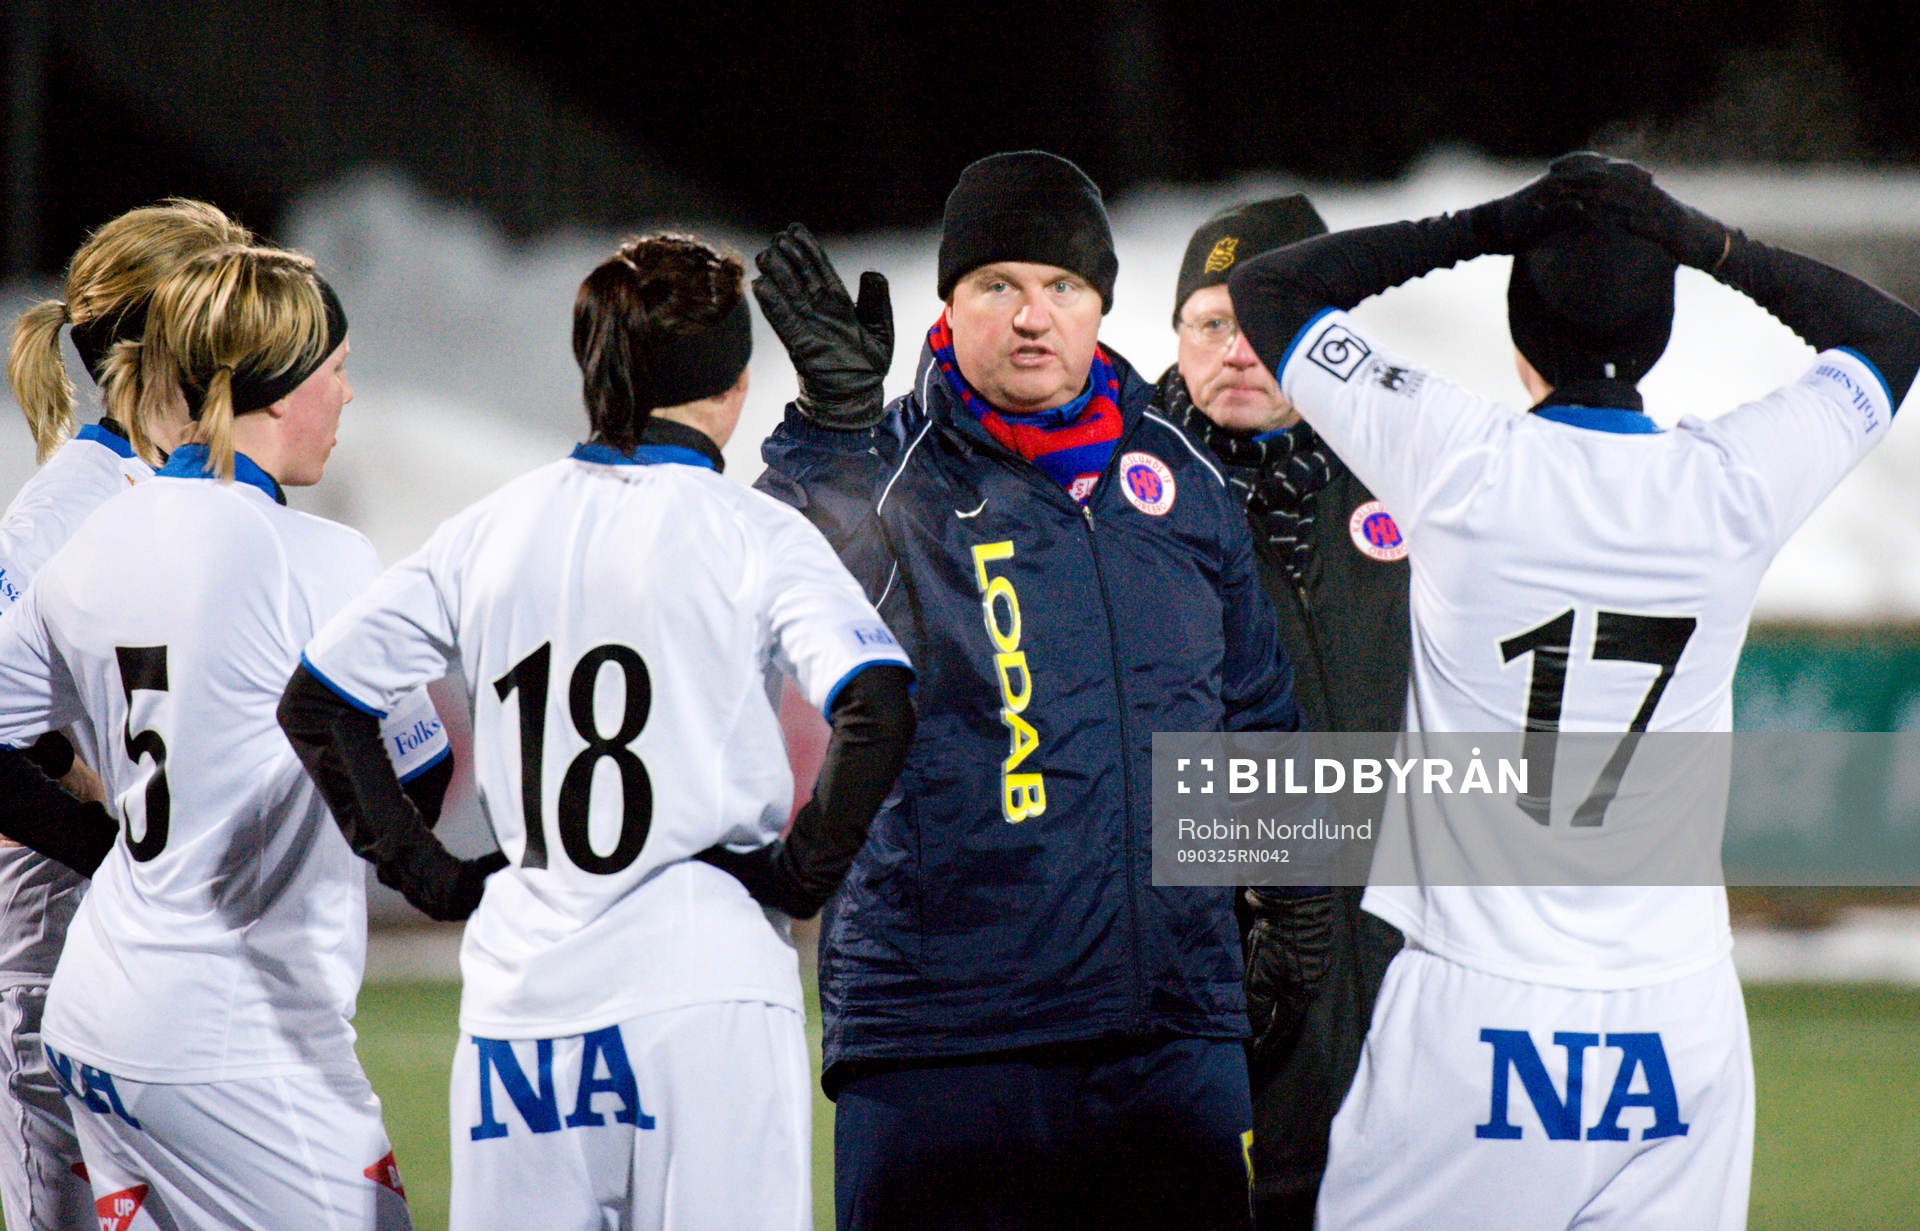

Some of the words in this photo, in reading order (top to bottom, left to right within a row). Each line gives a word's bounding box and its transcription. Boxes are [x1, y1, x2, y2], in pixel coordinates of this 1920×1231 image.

[115, 645, 169, 863] 5
[493, 641, 653, 875] 18
[971, 540, 1046, 824] LODAB
[1500, 608, 1697, 827] 17
[471, 1024, 656, 1141] NA
[1475, 1028, 1689, 1141] NA
[114, 1198, 135, 1217] UP
